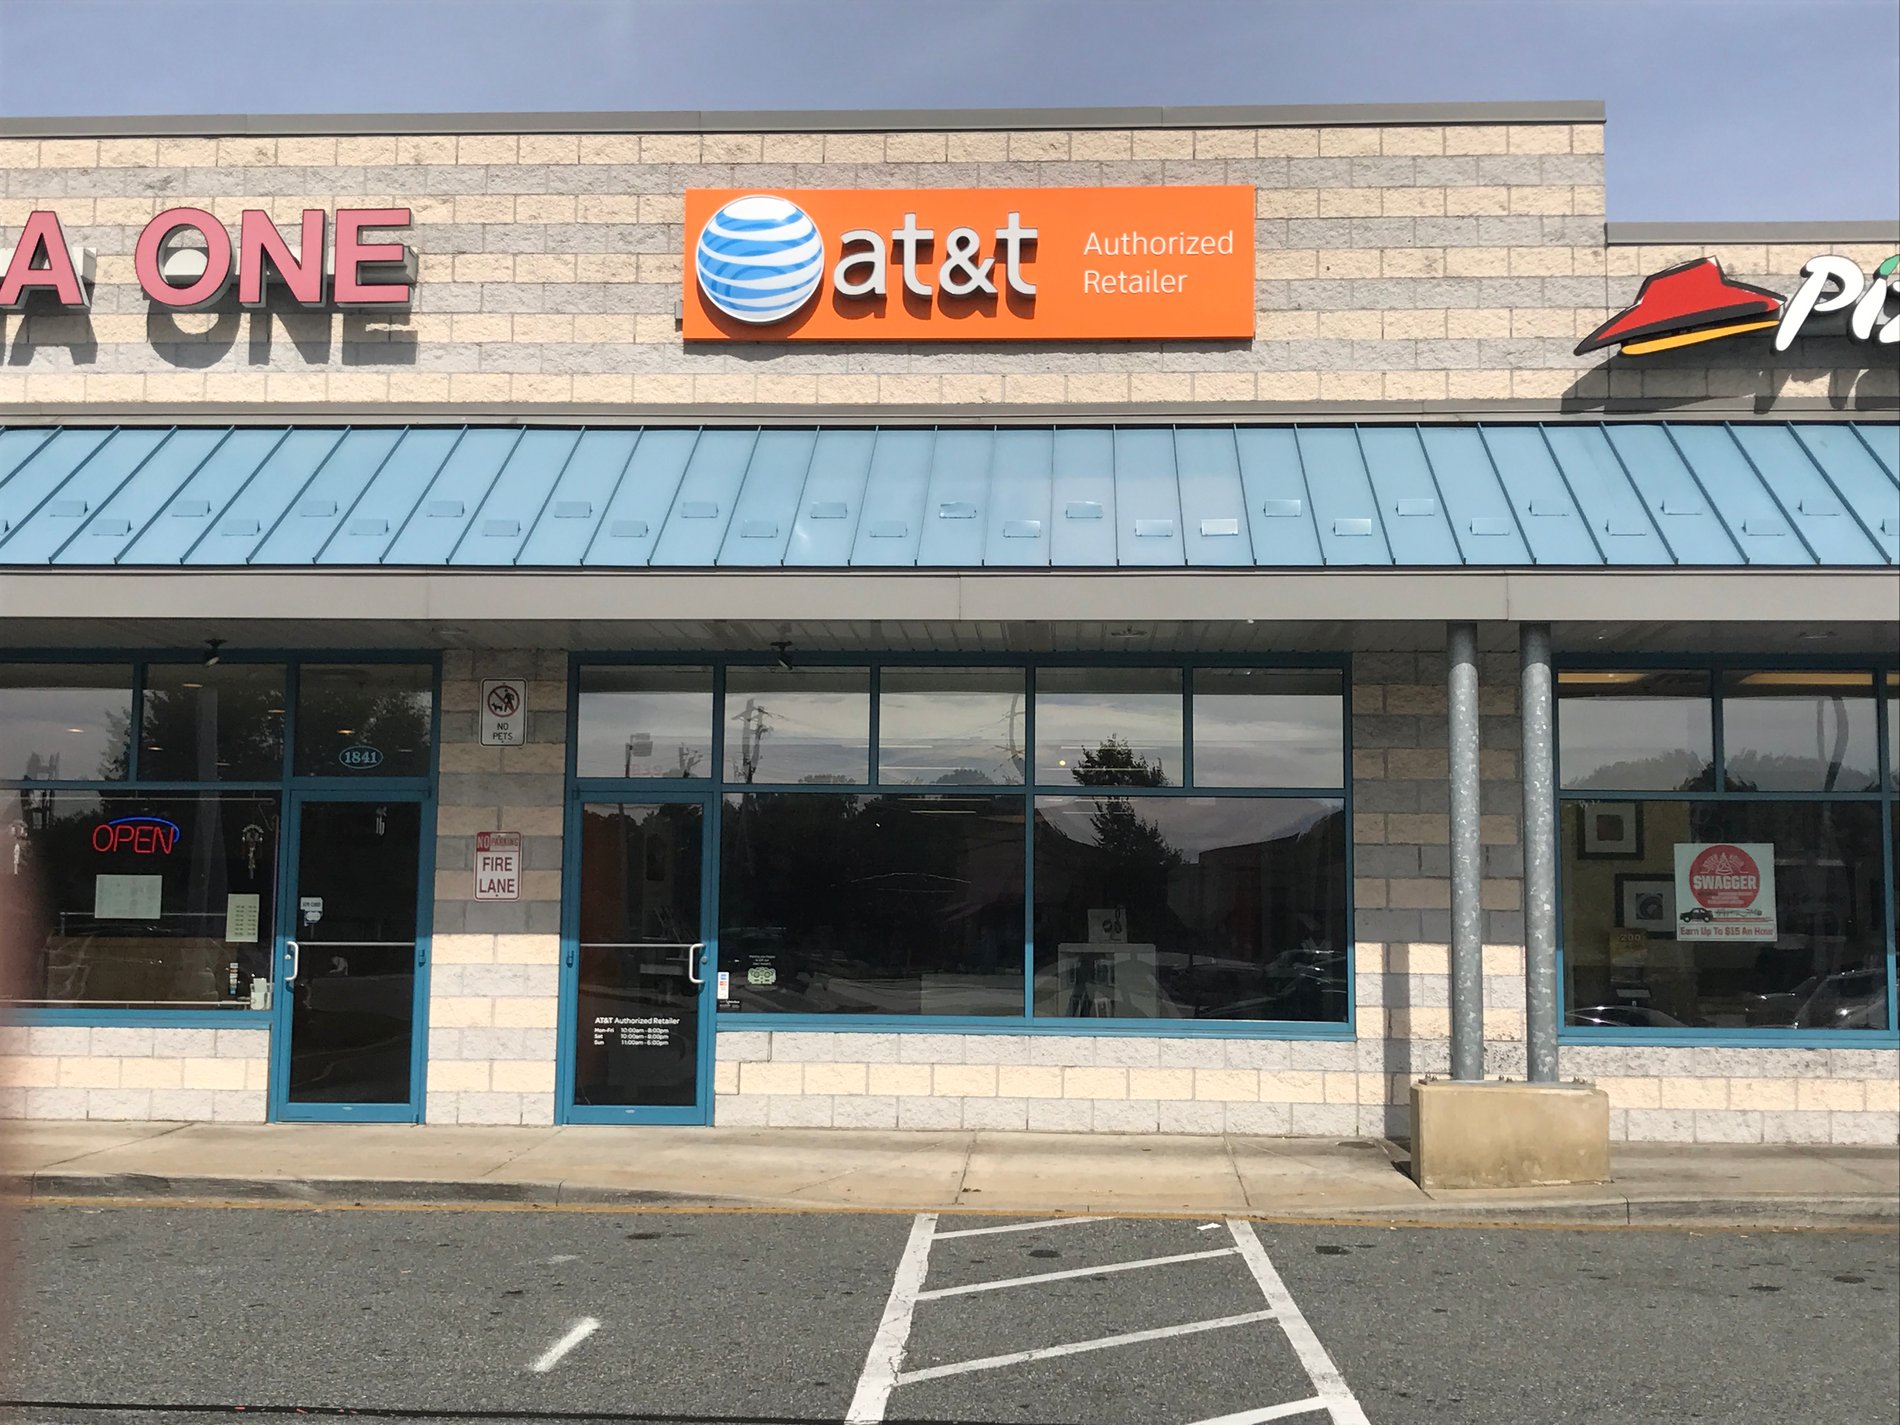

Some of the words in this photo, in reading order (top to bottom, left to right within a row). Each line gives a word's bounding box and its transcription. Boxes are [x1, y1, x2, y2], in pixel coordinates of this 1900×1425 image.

[1083, 230, 1234, 255] Authorized
[135, 207, 411, 306] ONE
[833, 211, 1039, 296] at&t
[1084, 269, 1188, 294] Retailer
[497, 722, 509, 731] NO
[492, 732, 513, 741] PETS
[344, 751, 378, 764] 1841
[92, 824, 175, 855] OPEN
[477, 835, 490, 849] NO
[490, 837, 519, 847] PARKING
[482, 856, 513, 872] FIRE
[479, 878, 515, 894] LANE
[1693, 875, 1757, 890] SWAGGER
[1680, 926, 1699, 936] Earn
[1700, 926, 1711, 937] Up
[1713, 926, 1722, 936] To
[1724, 926, 1740, 937] $15
[1742, 926, 1753, 936] An
